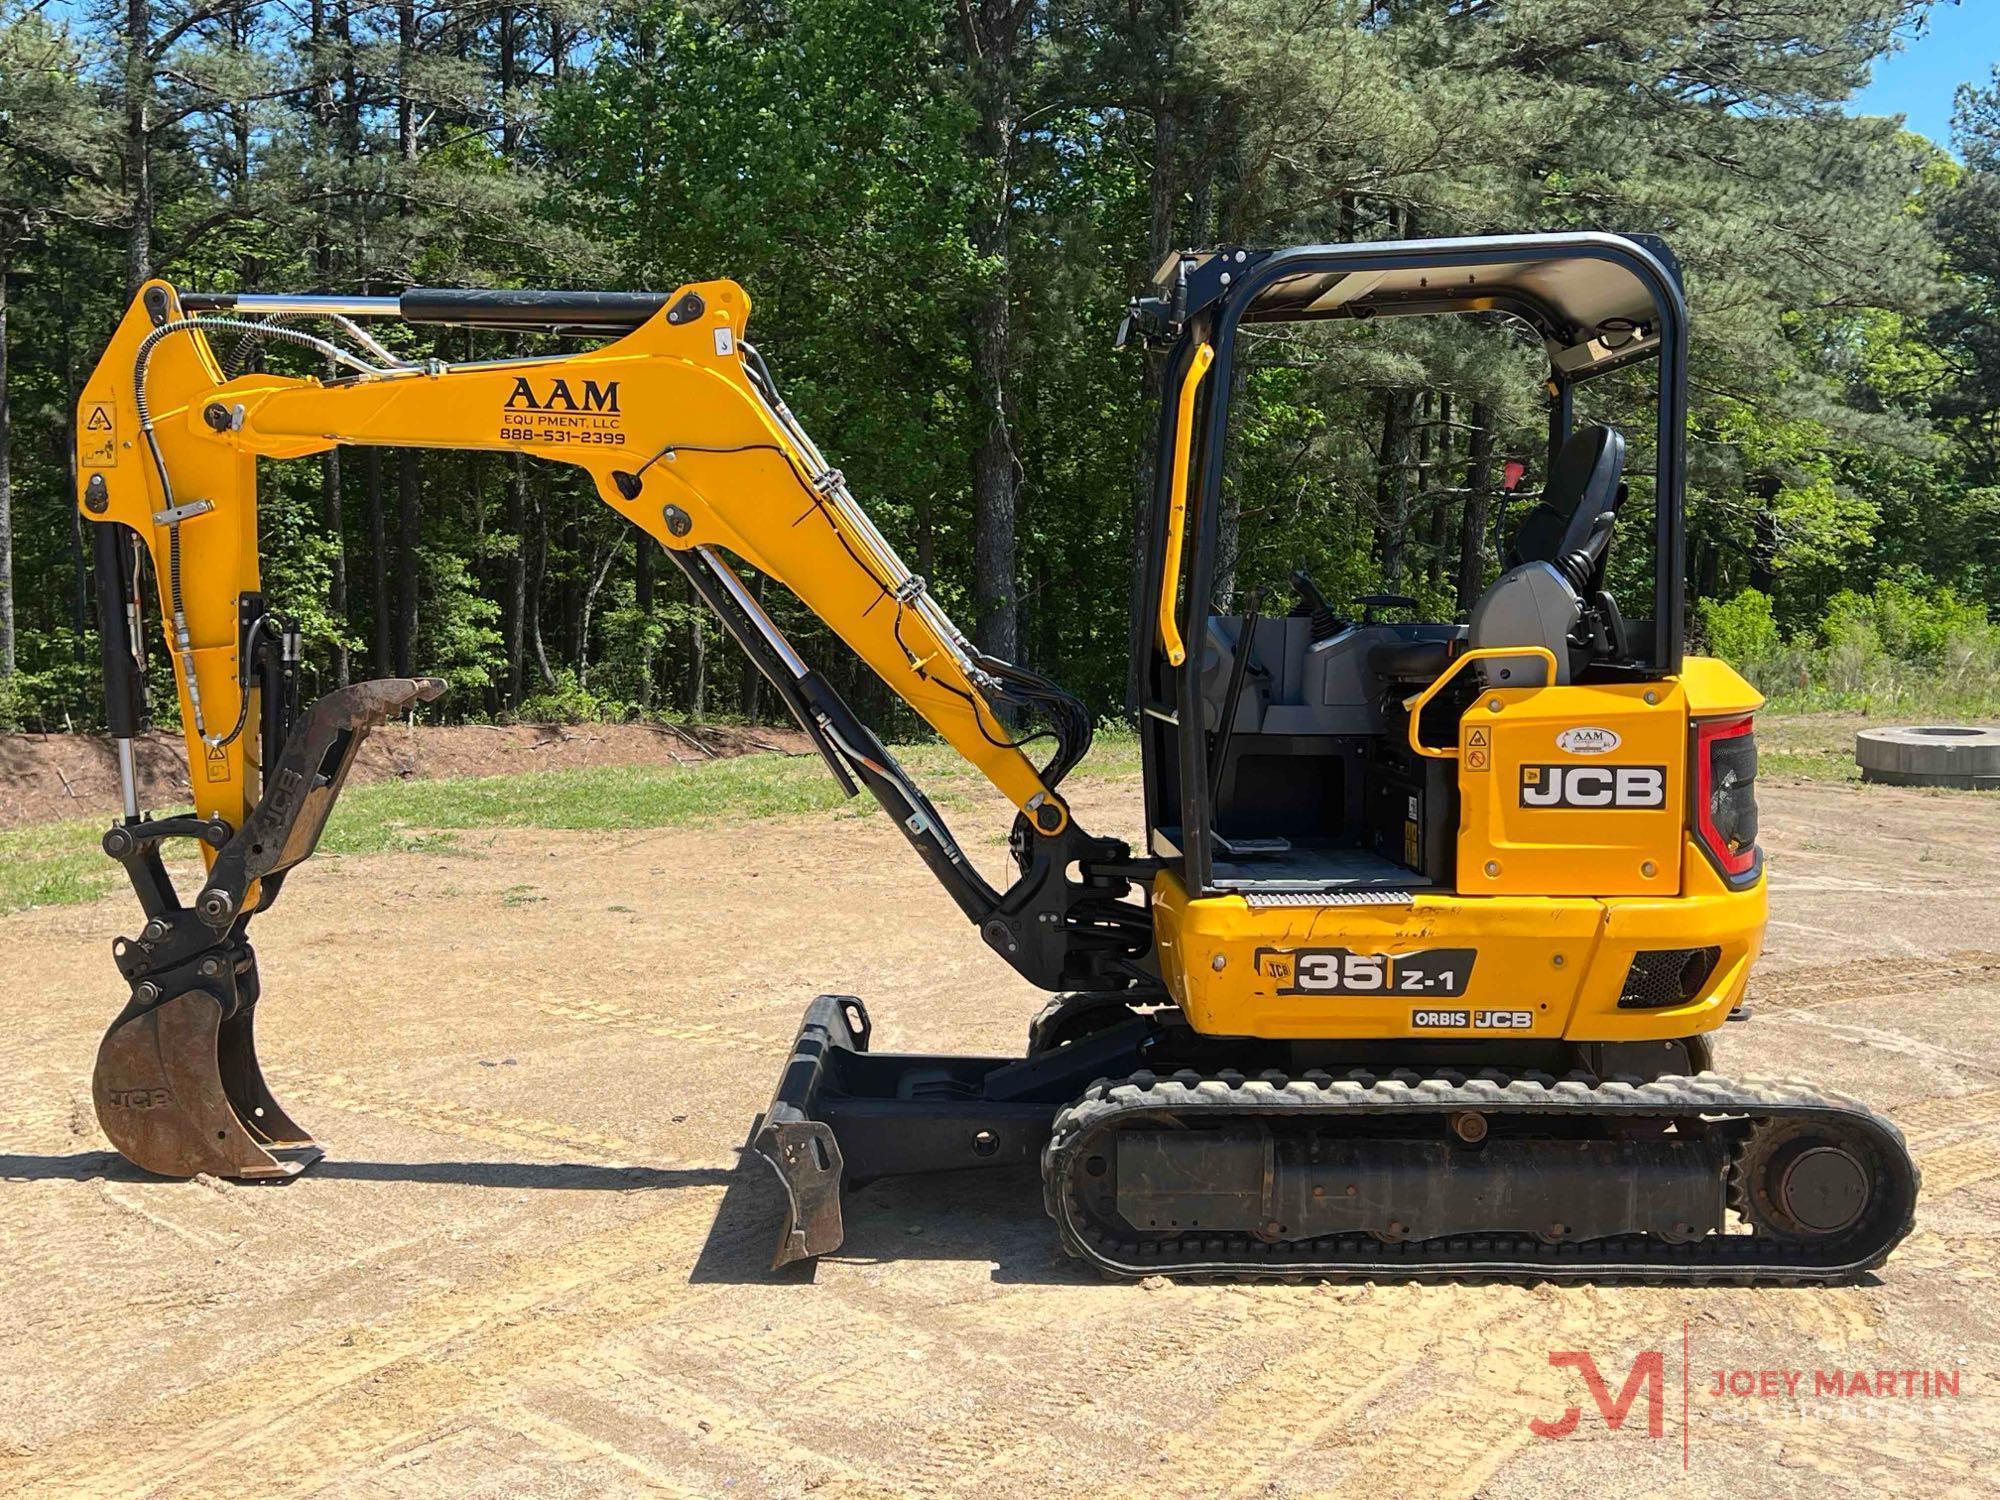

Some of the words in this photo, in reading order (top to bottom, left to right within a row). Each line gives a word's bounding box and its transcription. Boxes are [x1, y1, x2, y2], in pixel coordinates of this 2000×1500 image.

[504, 377, 621, 412] AAM
[504, 414, 590, 429] EQUPMENT,
[593, 418, 620, 429] LLC
[500, 428, 625, 445] 888-531-2399
[1574, 731, 1603, 740] AAM
[1523, 768, 1663, 806] JCB
[264, 767, 303, 829] JCB
[1269, 962, 1290, 979] JCB
[1299, 954, 1383, 990] 35
[1401, 970, 1454, 990] Z-1
[1415, 1012, 1466, 1027] ORBIS
[1475, 1012, 1532, 1028] JCB
[109, 1088, 170, 1109] JCB
